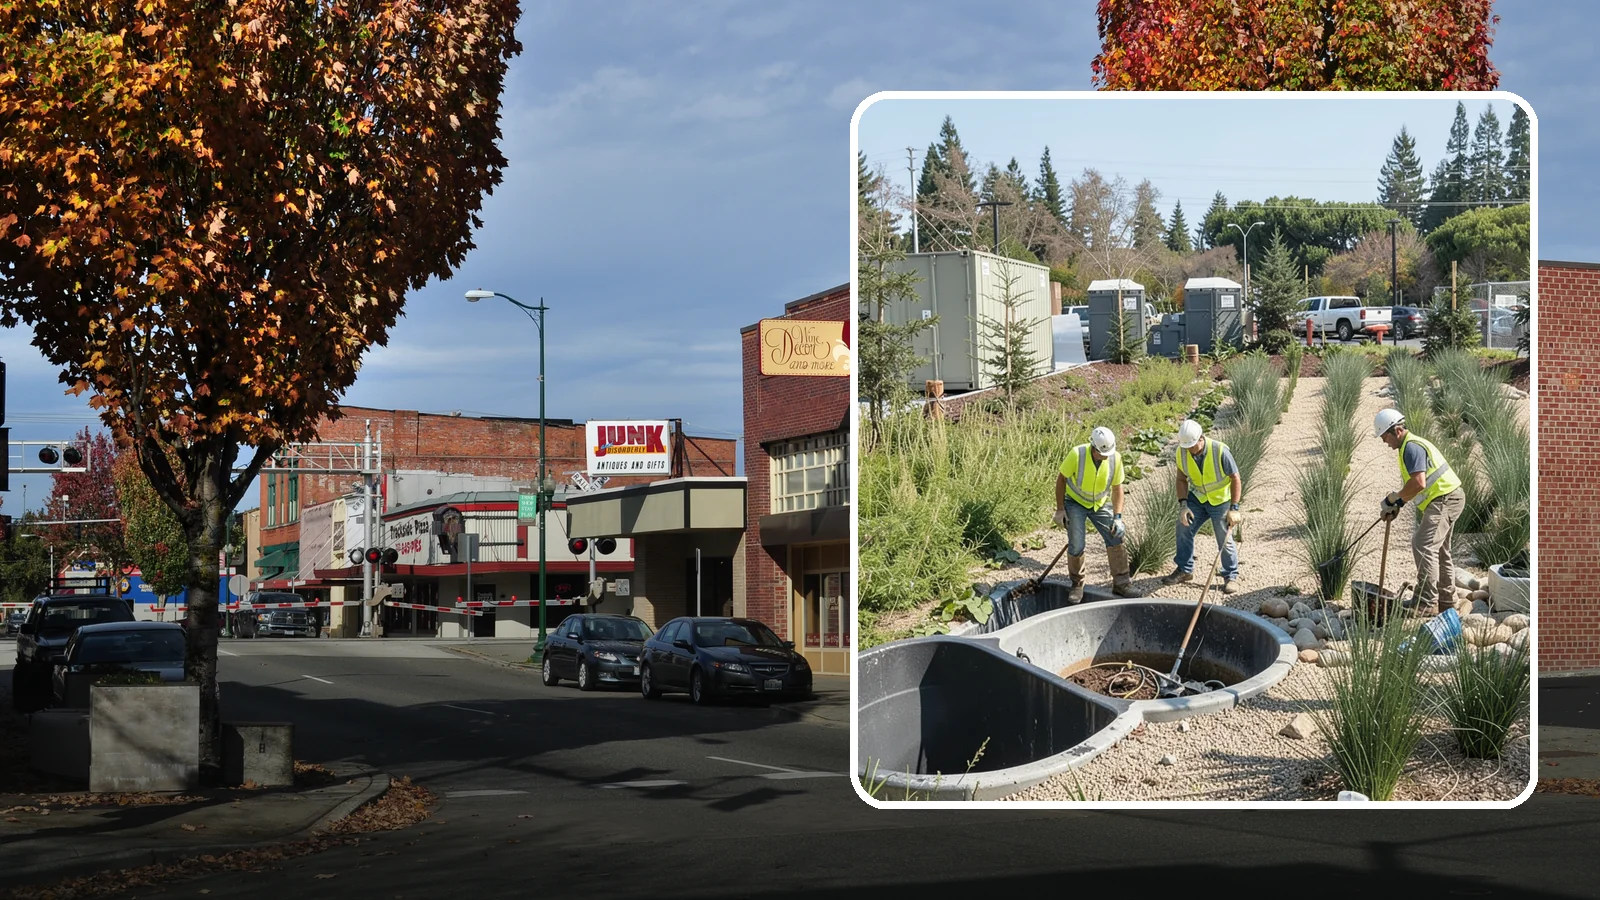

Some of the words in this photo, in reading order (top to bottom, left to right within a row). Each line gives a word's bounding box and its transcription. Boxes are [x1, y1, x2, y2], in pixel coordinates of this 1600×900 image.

[596, 425, 665, 457] JUNK
[607, 446, 646, 454] DISORDERLY
[597, 461, 628, 470] ANTIQUES
[631, 461, 644, 470] AND
[647, 460, 665, 470] GIFTS
[414, 519, 429, 535] Pizza
